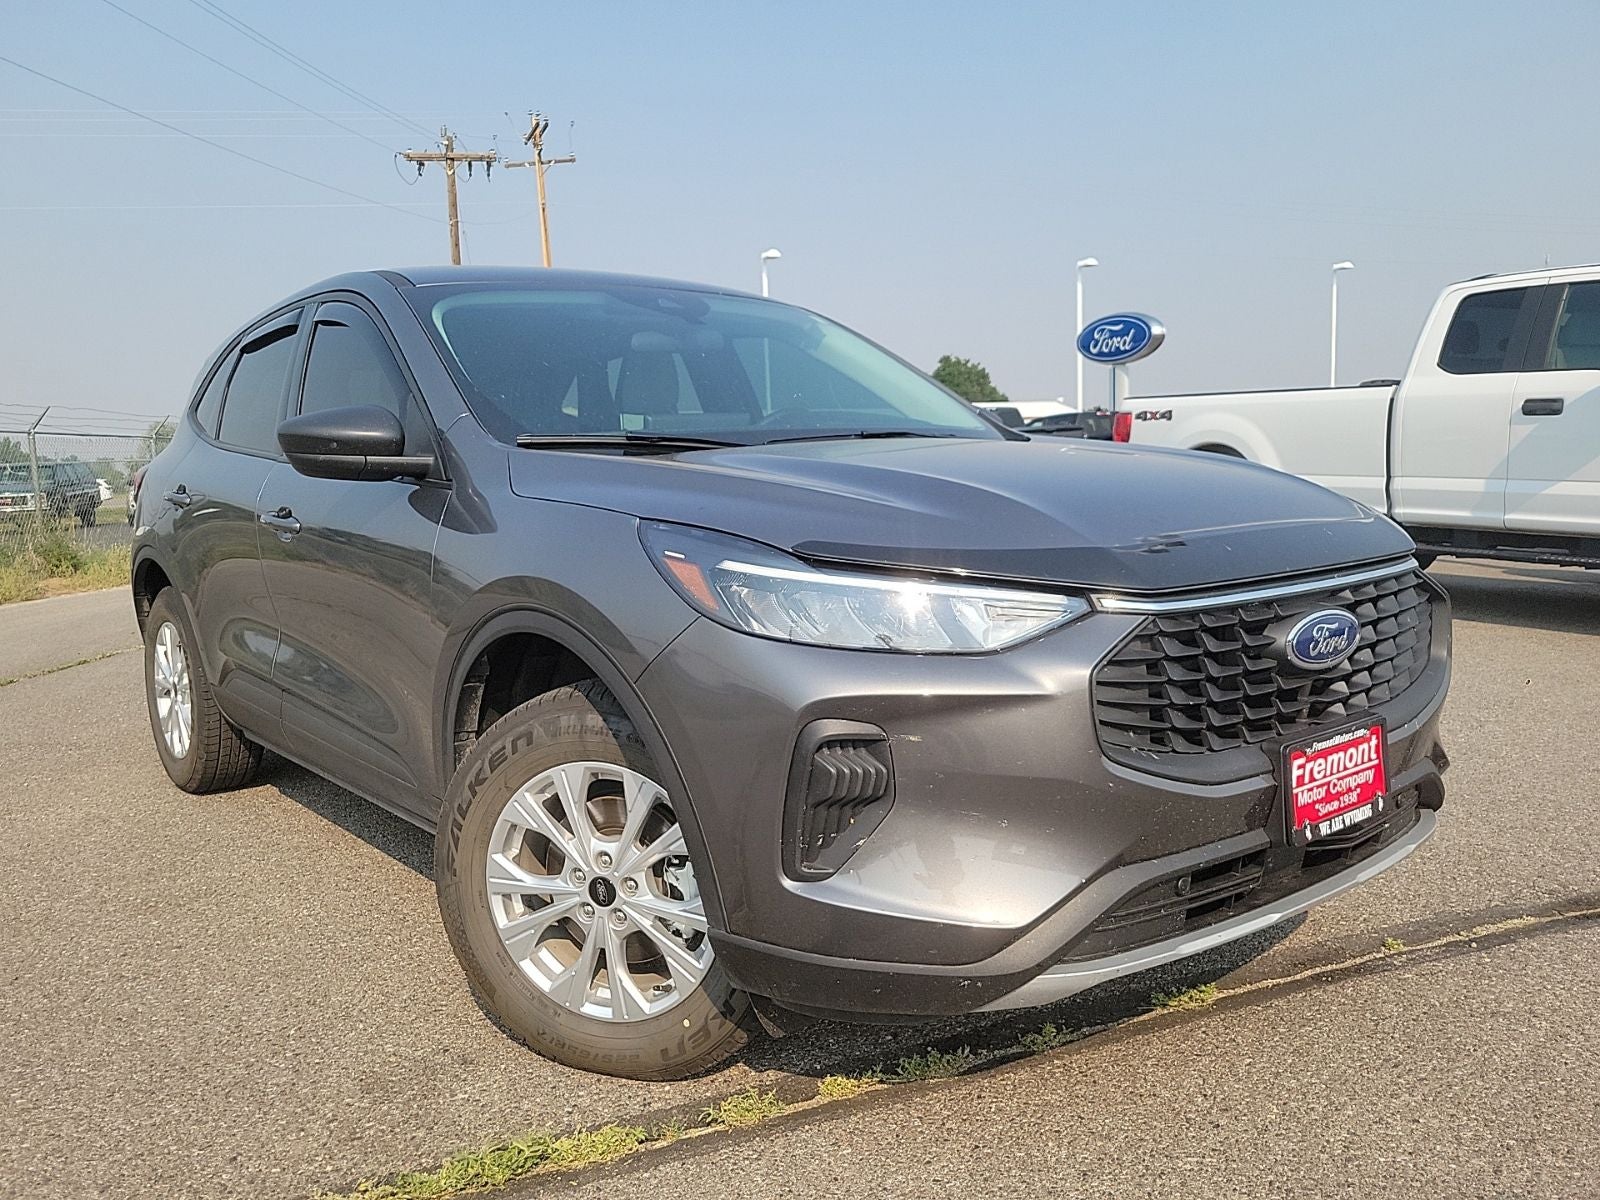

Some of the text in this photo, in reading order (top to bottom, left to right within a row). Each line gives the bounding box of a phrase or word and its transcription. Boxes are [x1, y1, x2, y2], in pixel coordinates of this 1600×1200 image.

[1089, 323, 1136, 354] Ford
[1309, 622, 1349, 657] Ford
[1291, 734, 1378, 788] Fremont
[1297, 768, 1375, 807] Motor Company
[1319, 803, 1372, 837] WE ARE WYOMING
